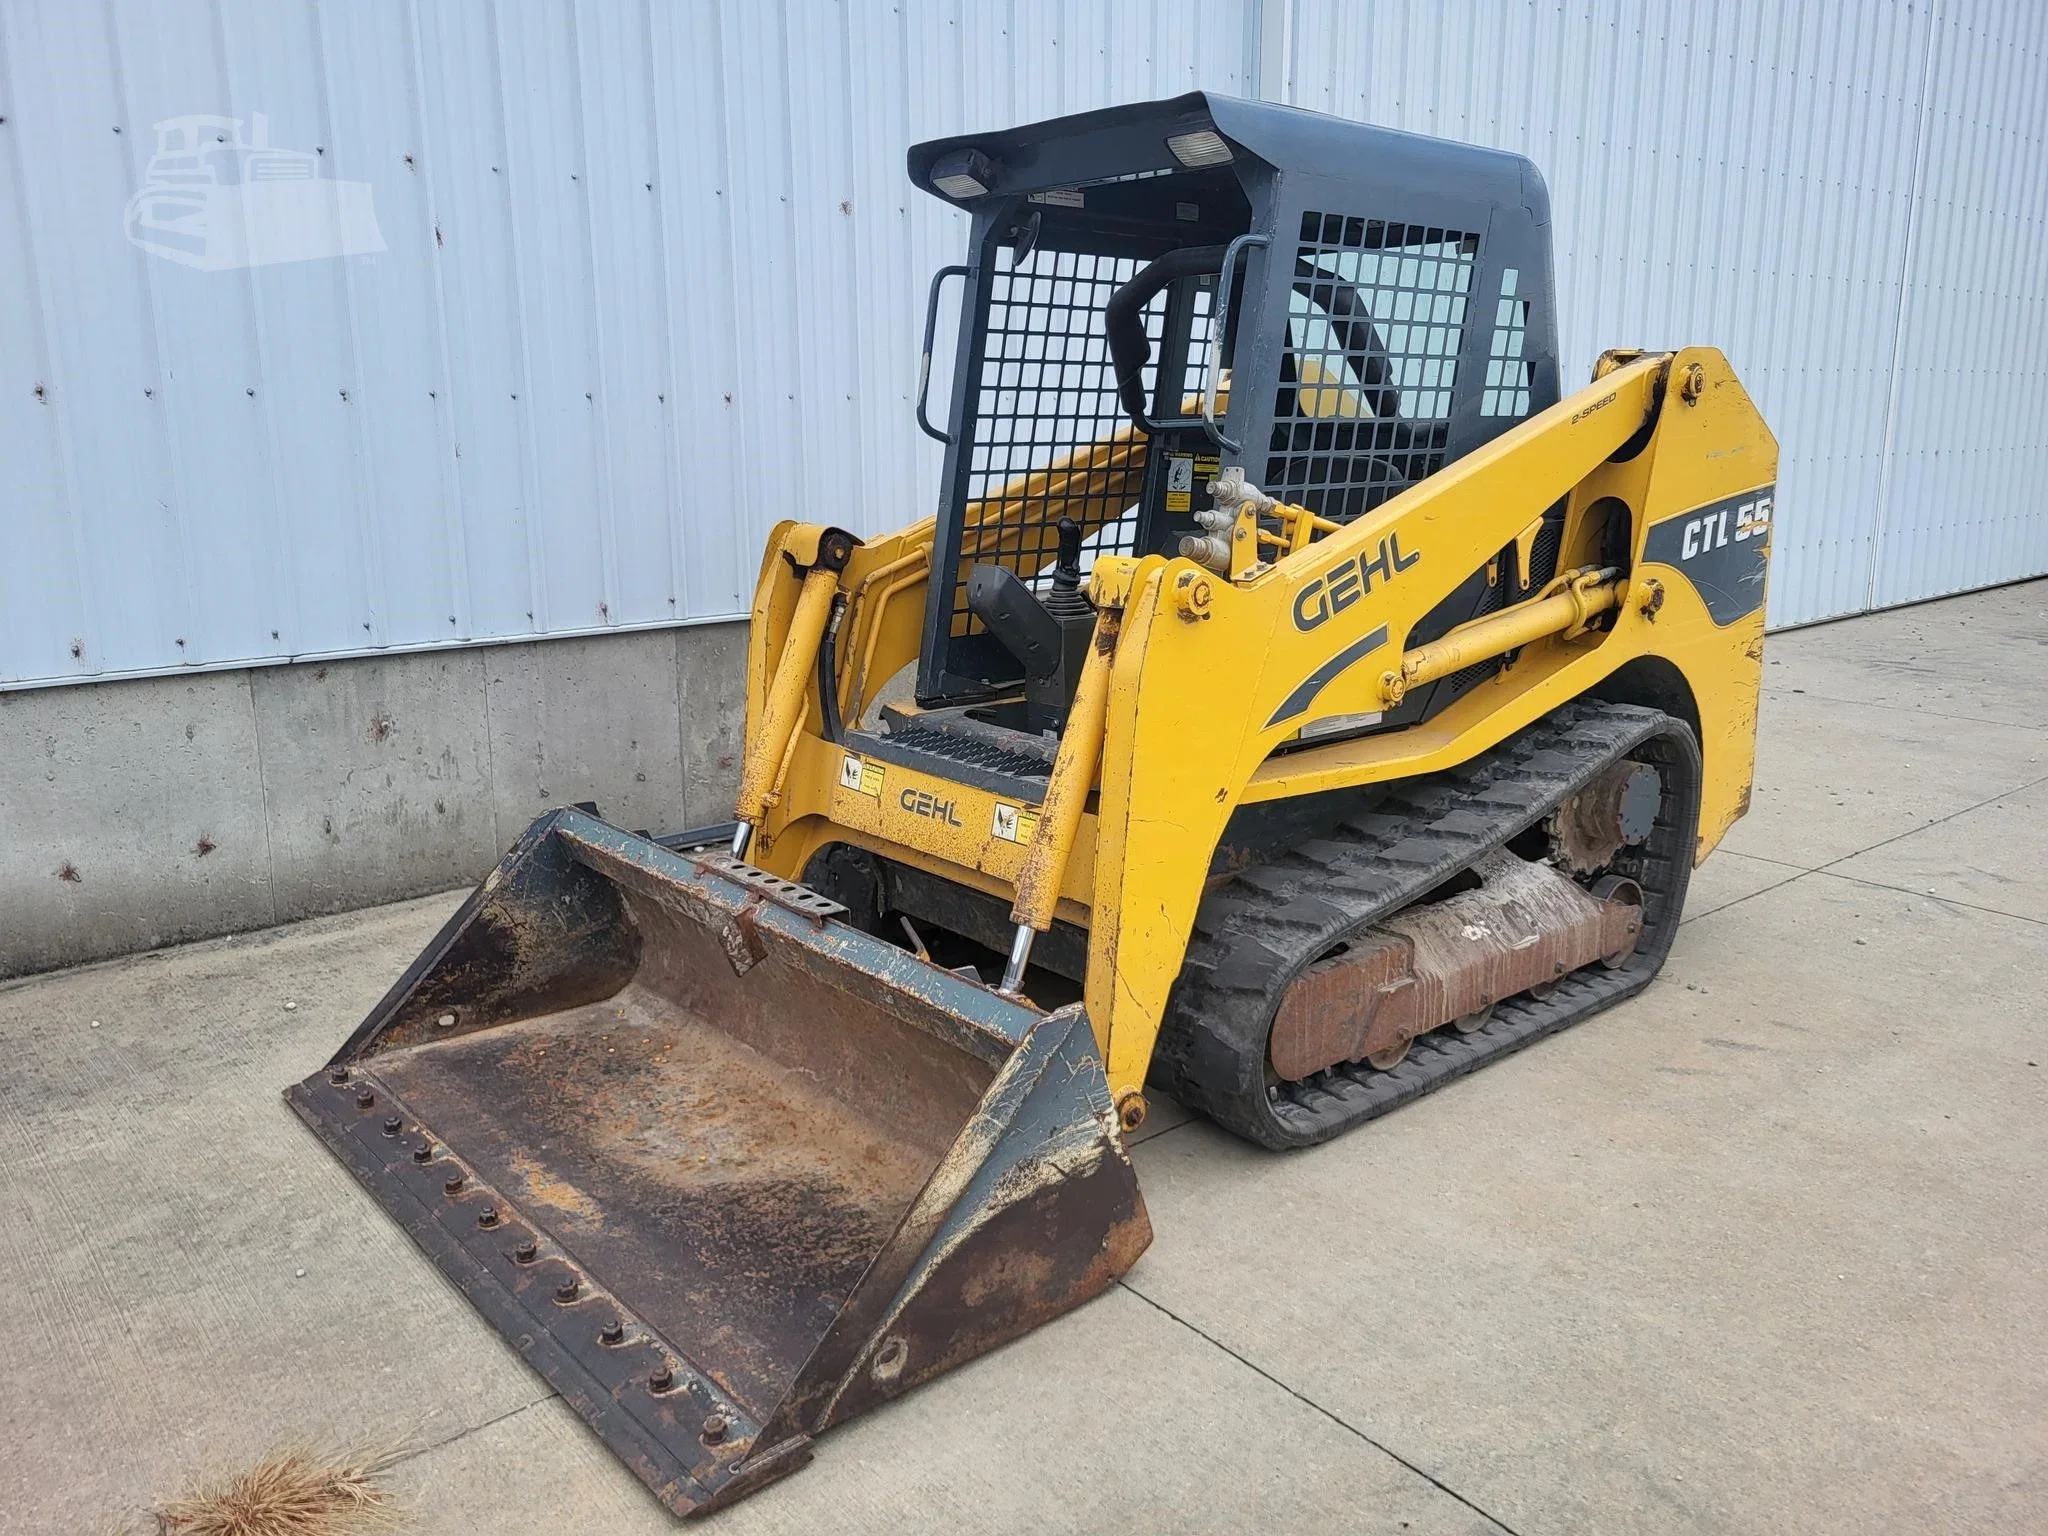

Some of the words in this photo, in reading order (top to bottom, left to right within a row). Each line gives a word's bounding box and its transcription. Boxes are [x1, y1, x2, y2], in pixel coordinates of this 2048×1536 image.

[1571, 392, 1617, 425] 2-SPEED
[1681, 509, 1729, 561] CTL
[1734, 497, 1772, 543] 55
[1293, 529, 1421, 633] GEHL
[900, 788, 963, 828] GEHL
